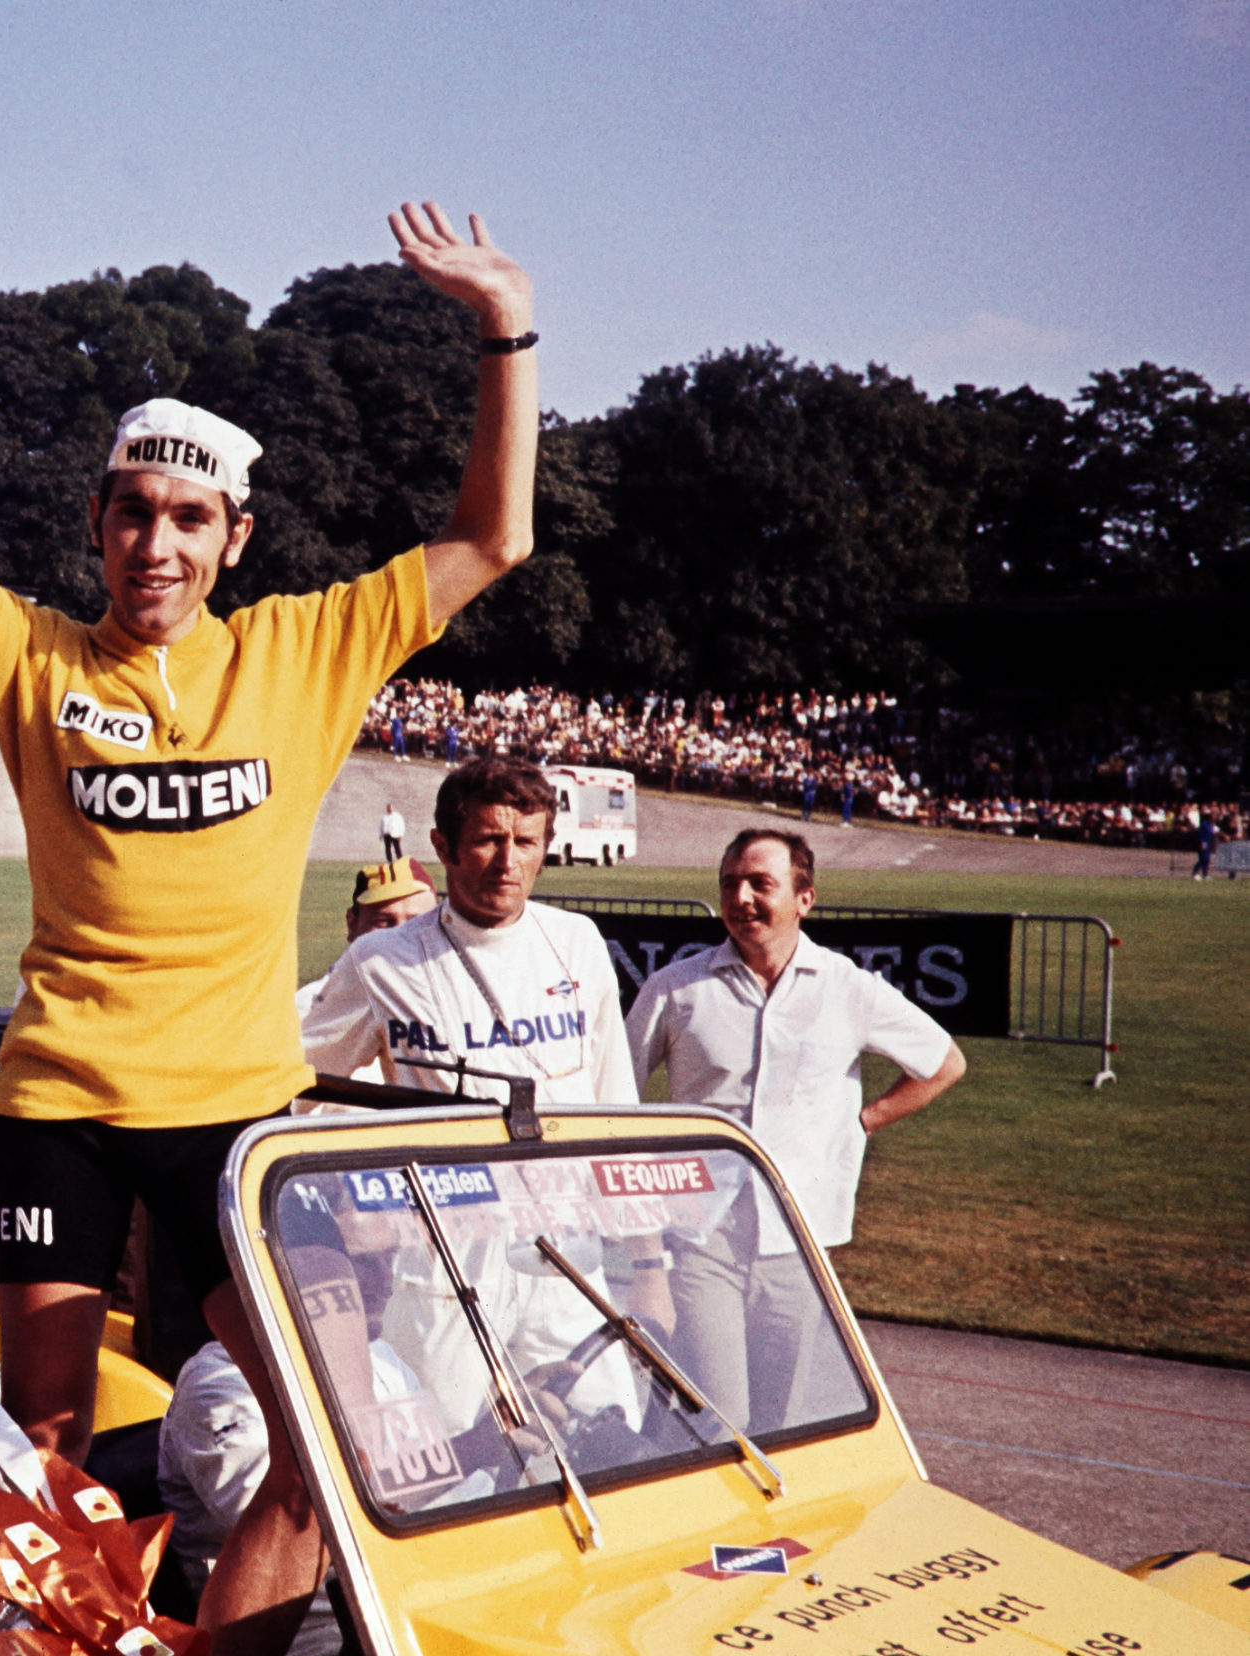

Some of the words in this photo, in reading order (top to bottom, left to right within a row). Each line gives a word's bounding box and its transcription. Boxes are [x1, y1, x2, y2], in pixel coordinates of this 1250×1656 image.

[127, 437, 217, 477] MOLTENI
[63, 700, 144, 742] MIKO
[71, 759, 267, 819] MOLTENI
[350, 1173, 387, 1201] Le
[385, 1168, 493, 1199] Prisien
[713, 1625, 774, 1650] ce
[775, 1584, 892, 1632] punch
[874, 1548, 1001, 1590] buggy
[936, 1592, 1047, 1644] offert
